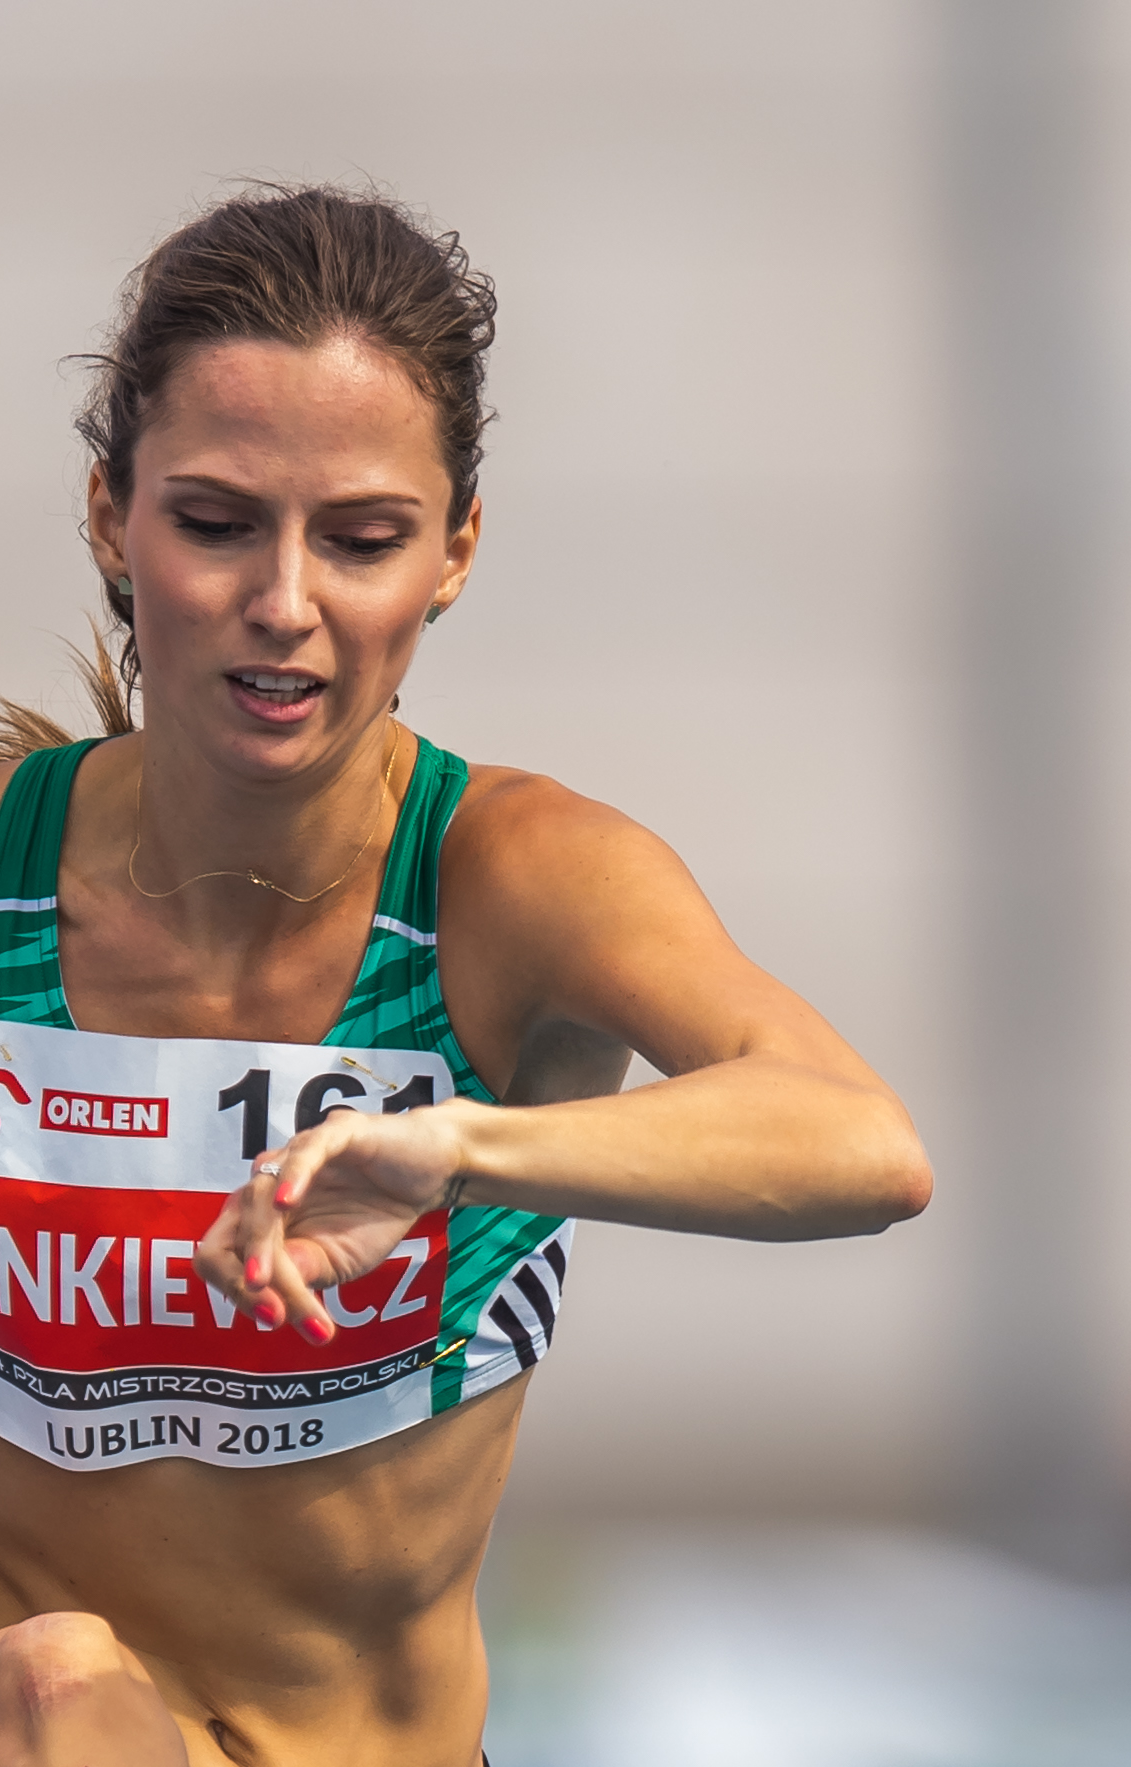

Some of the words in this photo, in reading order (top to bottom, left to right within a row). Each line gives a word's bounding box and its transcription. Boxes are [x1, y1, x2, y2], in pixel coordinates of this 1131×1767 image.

[47, 1096, 160, 1131] ORLEN
[14, 1364, 76, 1401] PZLA
[83, 1376, 312, 1401] MISTRZOSTWA
[319, 1352, 420, 1396] POLSKI
[46, 1414, 201, 1459] LUBLIN
[217, 1418, 324, 1455] 2018
